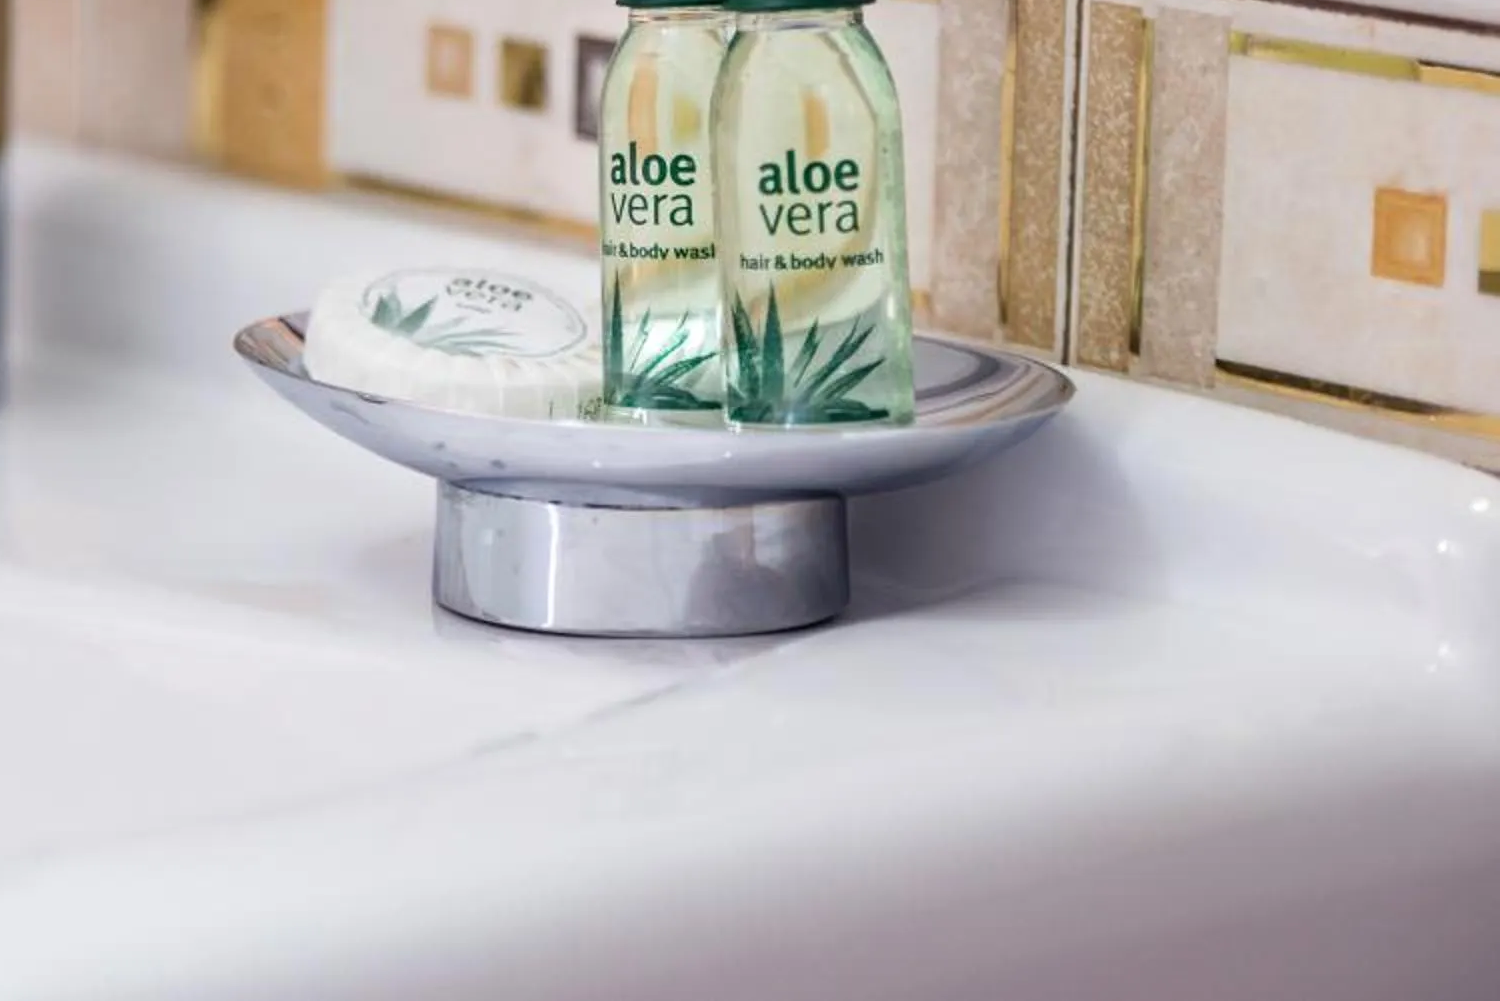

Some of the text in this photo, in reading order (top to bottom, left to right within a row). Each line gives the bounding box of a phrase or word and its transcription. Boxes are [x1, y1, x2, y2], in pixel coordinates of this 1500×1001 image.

[611, 141, 697, 186] aloe
[758, 148, 859, 196] aloe
[611, 192, 694, 226] vera
[759, 200, 859, 236] vera
[740, 247, 884, 270] hair & body wash
